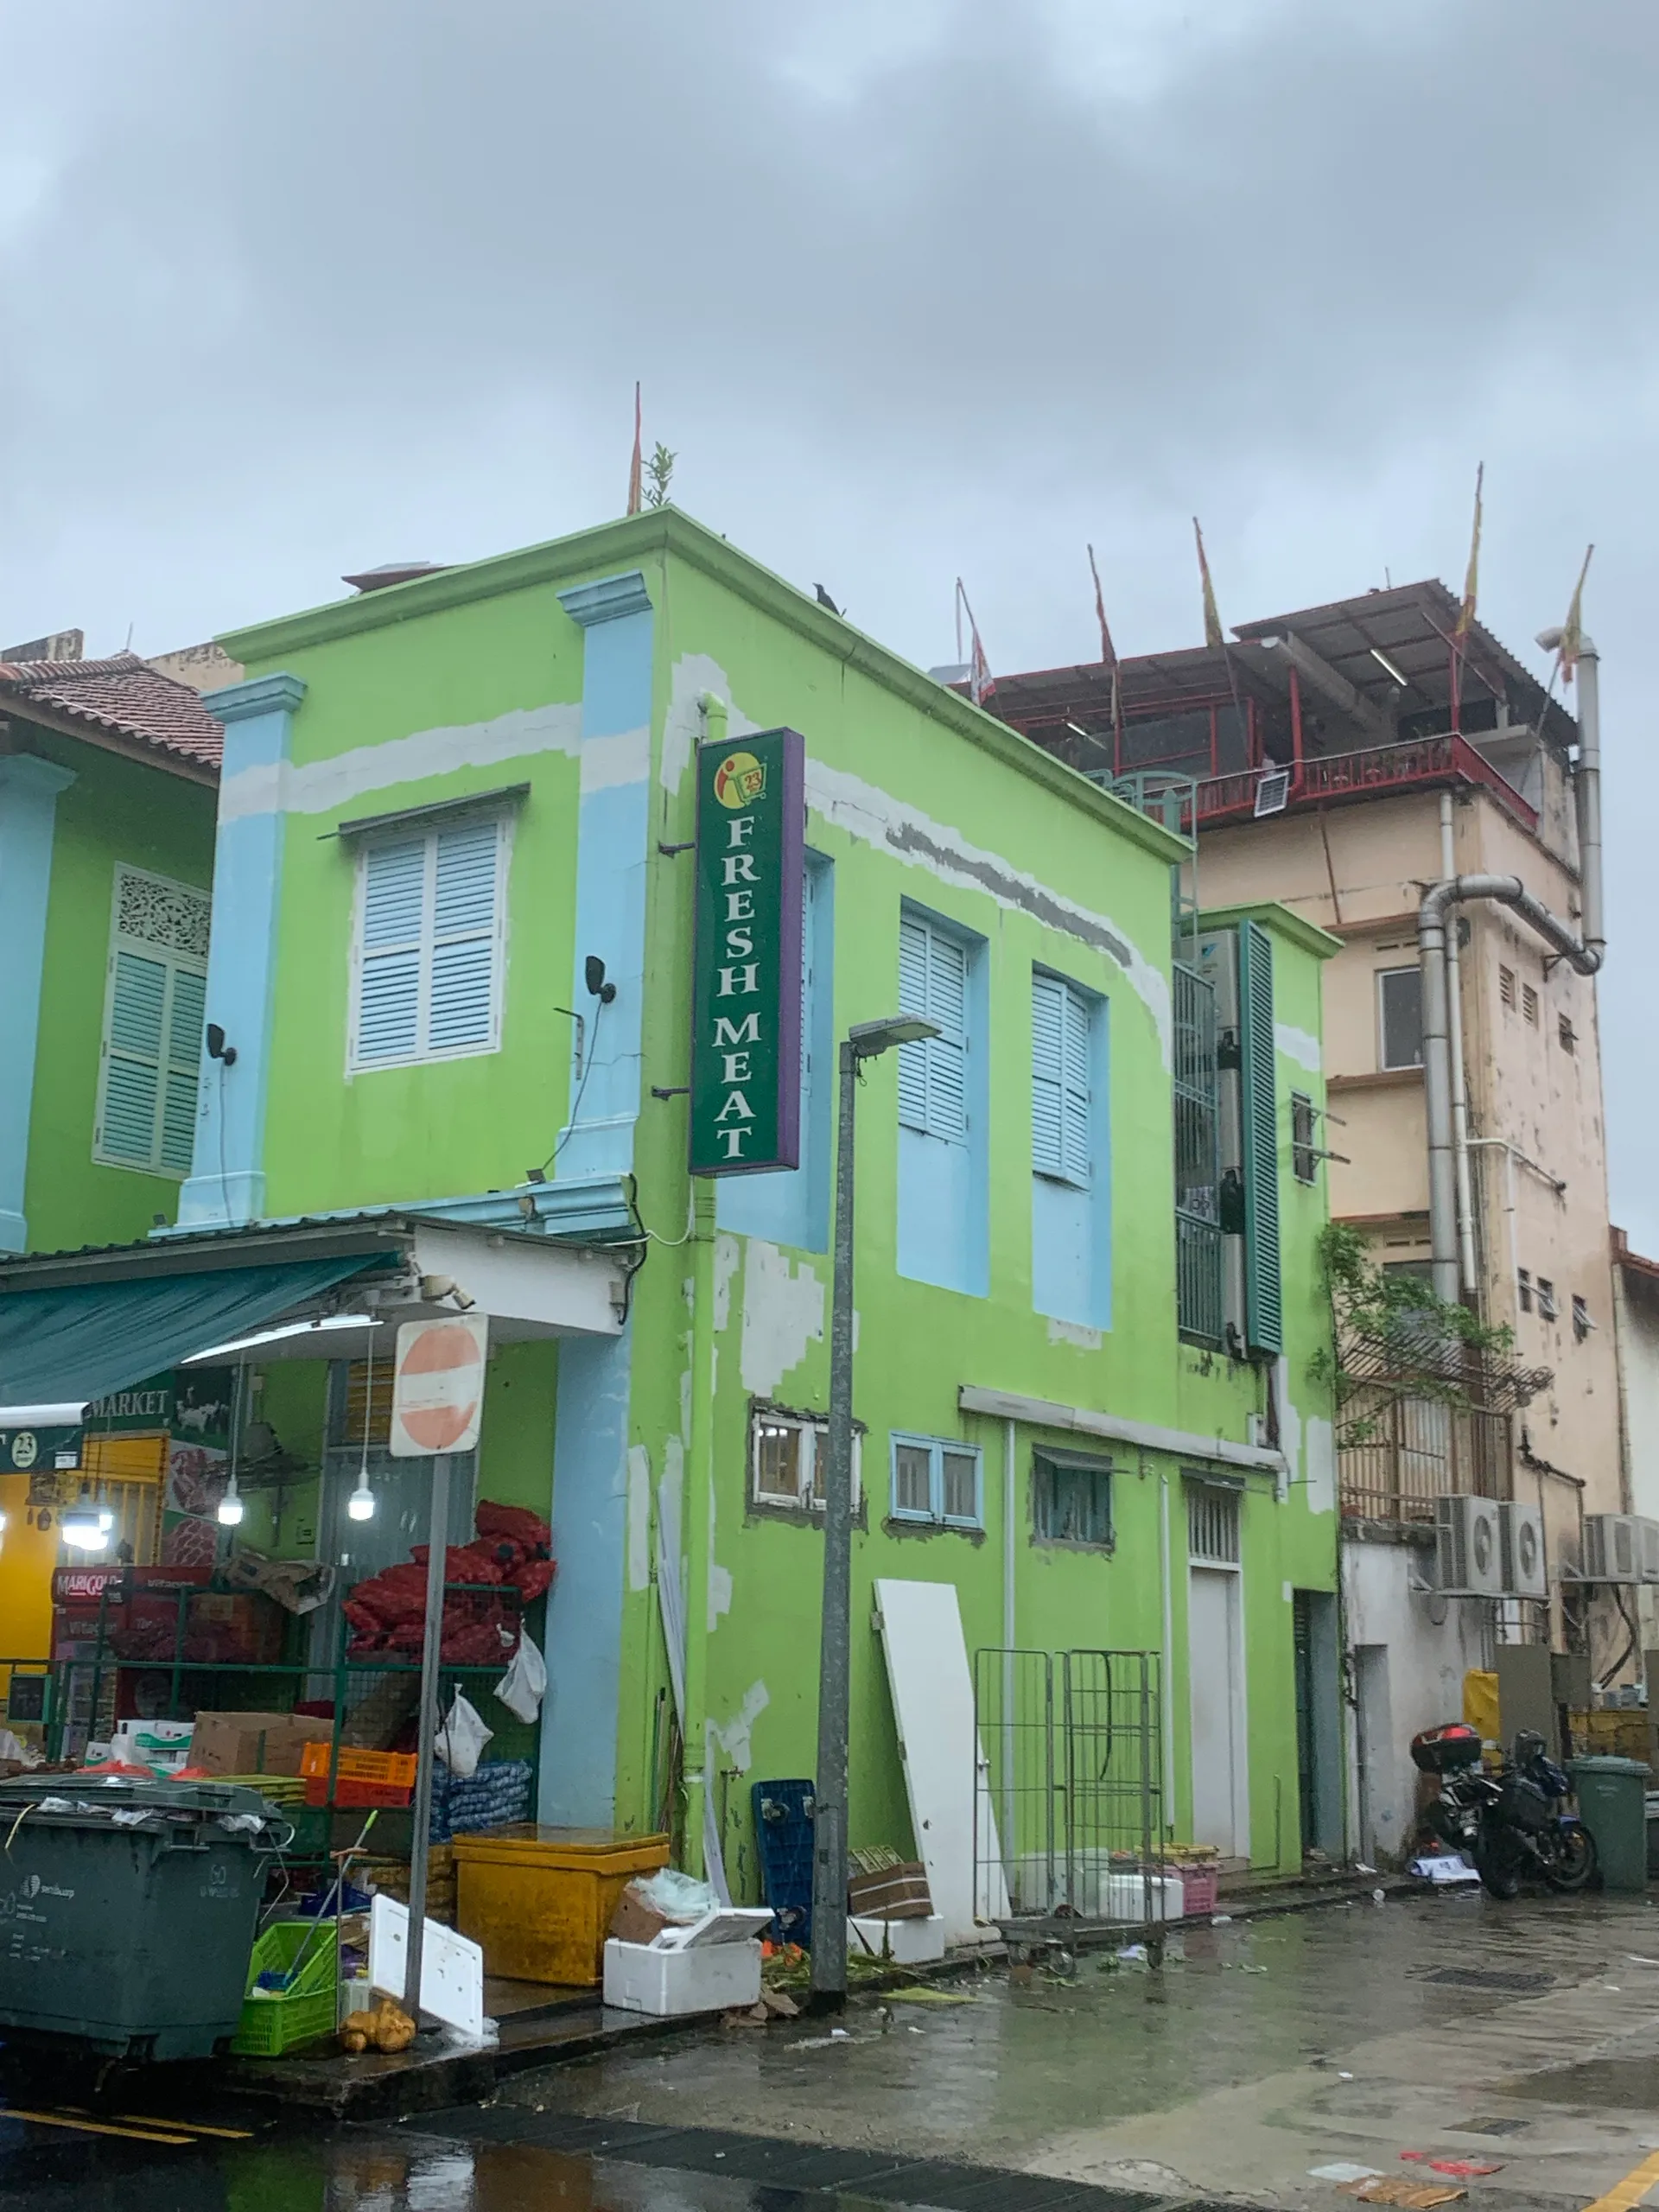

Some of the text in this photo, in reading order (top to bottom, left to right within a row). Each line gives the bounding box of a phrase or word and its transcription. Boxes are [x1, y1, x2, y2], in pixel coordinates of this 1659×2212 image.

[745, 772, 761, 789] 23
[711, 815, 762, 1160] FRESH MEAT
